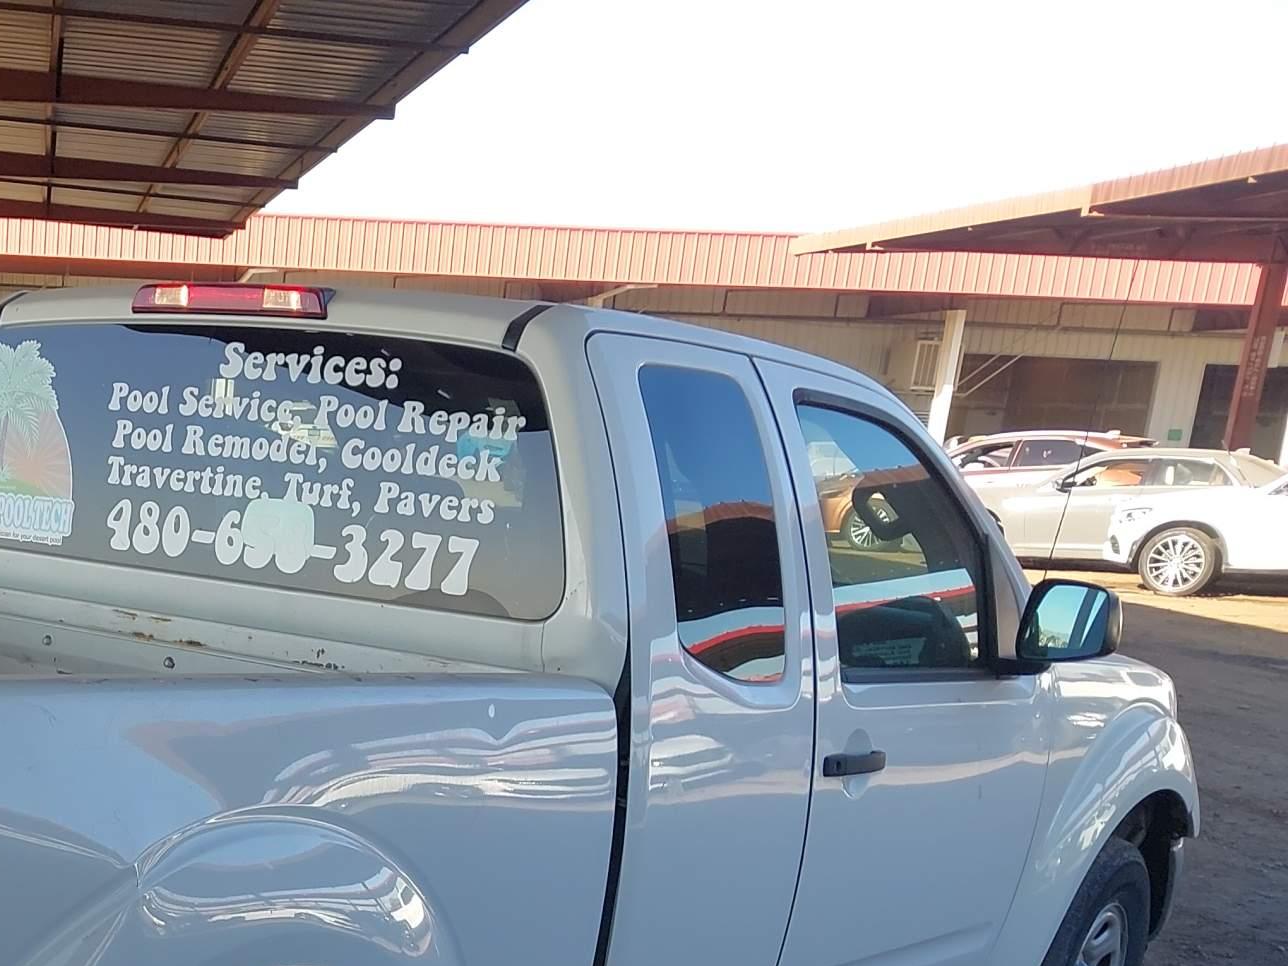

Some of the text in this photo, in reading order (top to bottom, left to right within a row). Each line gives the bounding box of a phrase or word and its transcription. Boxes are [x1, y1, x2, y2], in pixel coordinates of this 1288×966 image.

[220, 342, 402, 389] Services:
[108, 382, 170, 415] Pool
[314, 395, 389, 431] Pool
[397, 401, 527, 442] Repair
[111, 419, 502, 483] Pool Remodel, Cooldeck
[33, 499, 71, 534] TECH
[284, 472, 361, 517] Turf,
[373, 481, 496, 525] Pavers
[106, 498, 480, 596] 480-6-3277
